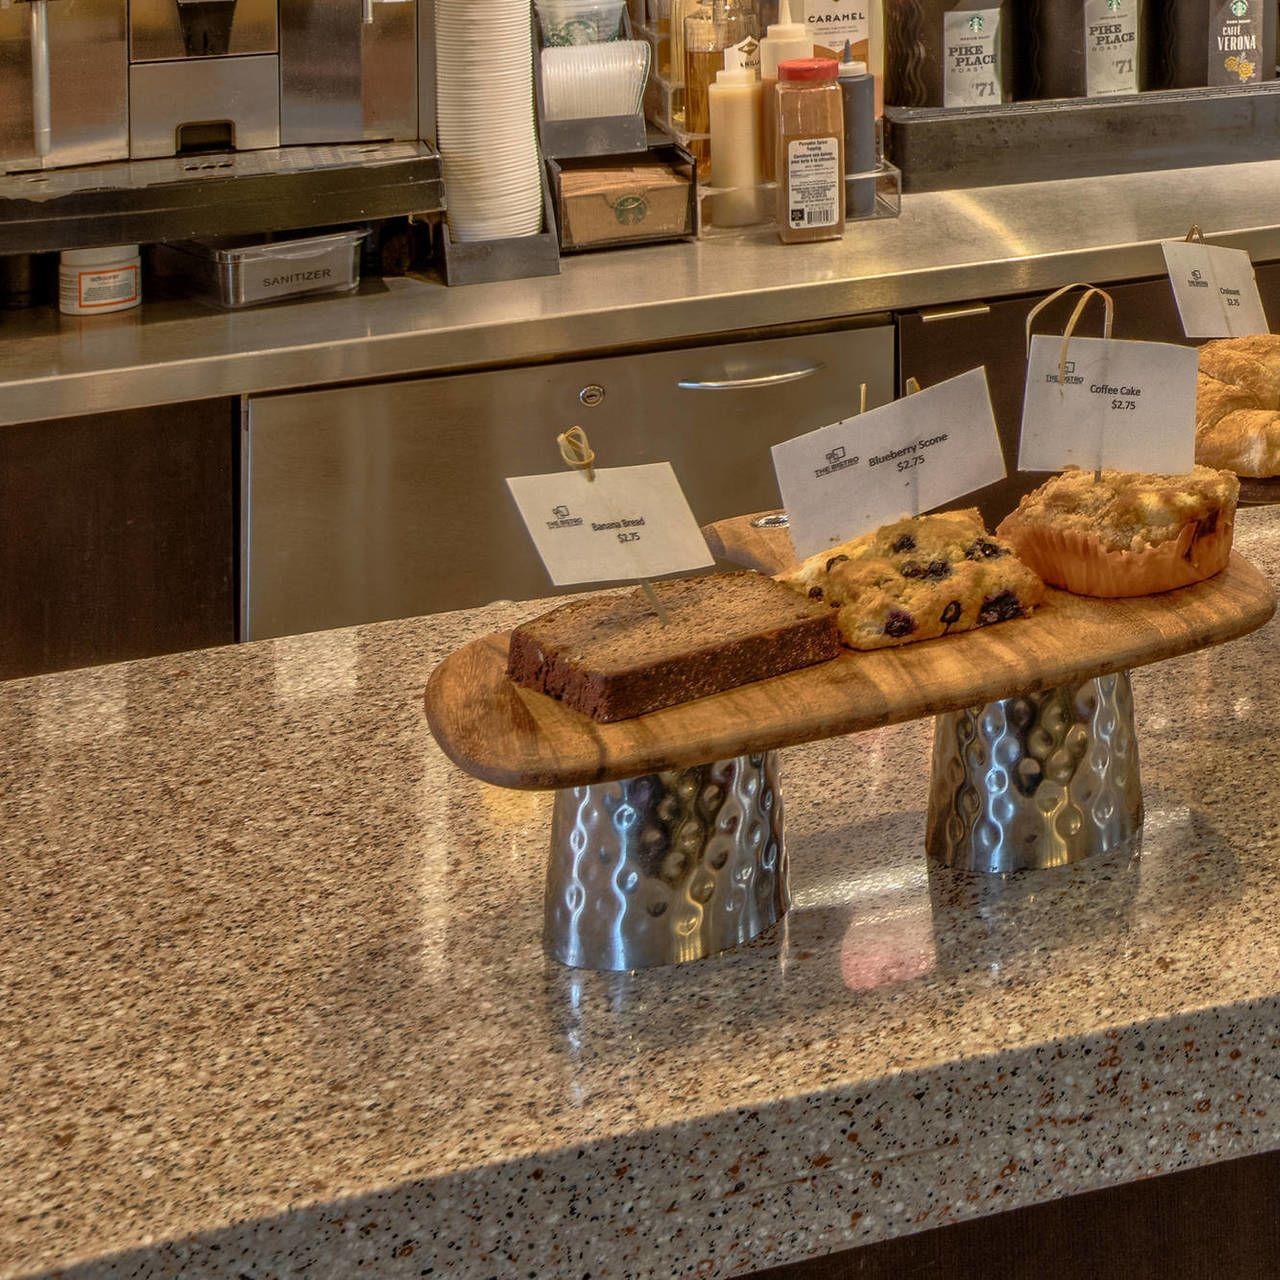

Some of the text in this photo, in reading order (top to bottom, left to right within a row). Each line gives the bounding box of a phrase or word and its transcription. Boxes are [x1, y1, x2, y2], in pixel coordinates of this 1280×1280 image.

[808, 11, 865, 23] CARAMEL
[1089, 24, 1122, 36] PIKE
[1095, 32, 1135, 46] PLACE
[1217, 35, 1257, 51] VERONA
[948, 44, 984, 57] PIKE
[955, 53, 998, 67] PLACE
[263, 268, 331, 287] SANITIZER
[1090, 384, 1141, 397] Coffee Cake
[1111, 399, 1136, 410] $2.75
[869, 433, 948, 467] Blueberry Scone
[897, 455, 925, 473] $2.75
